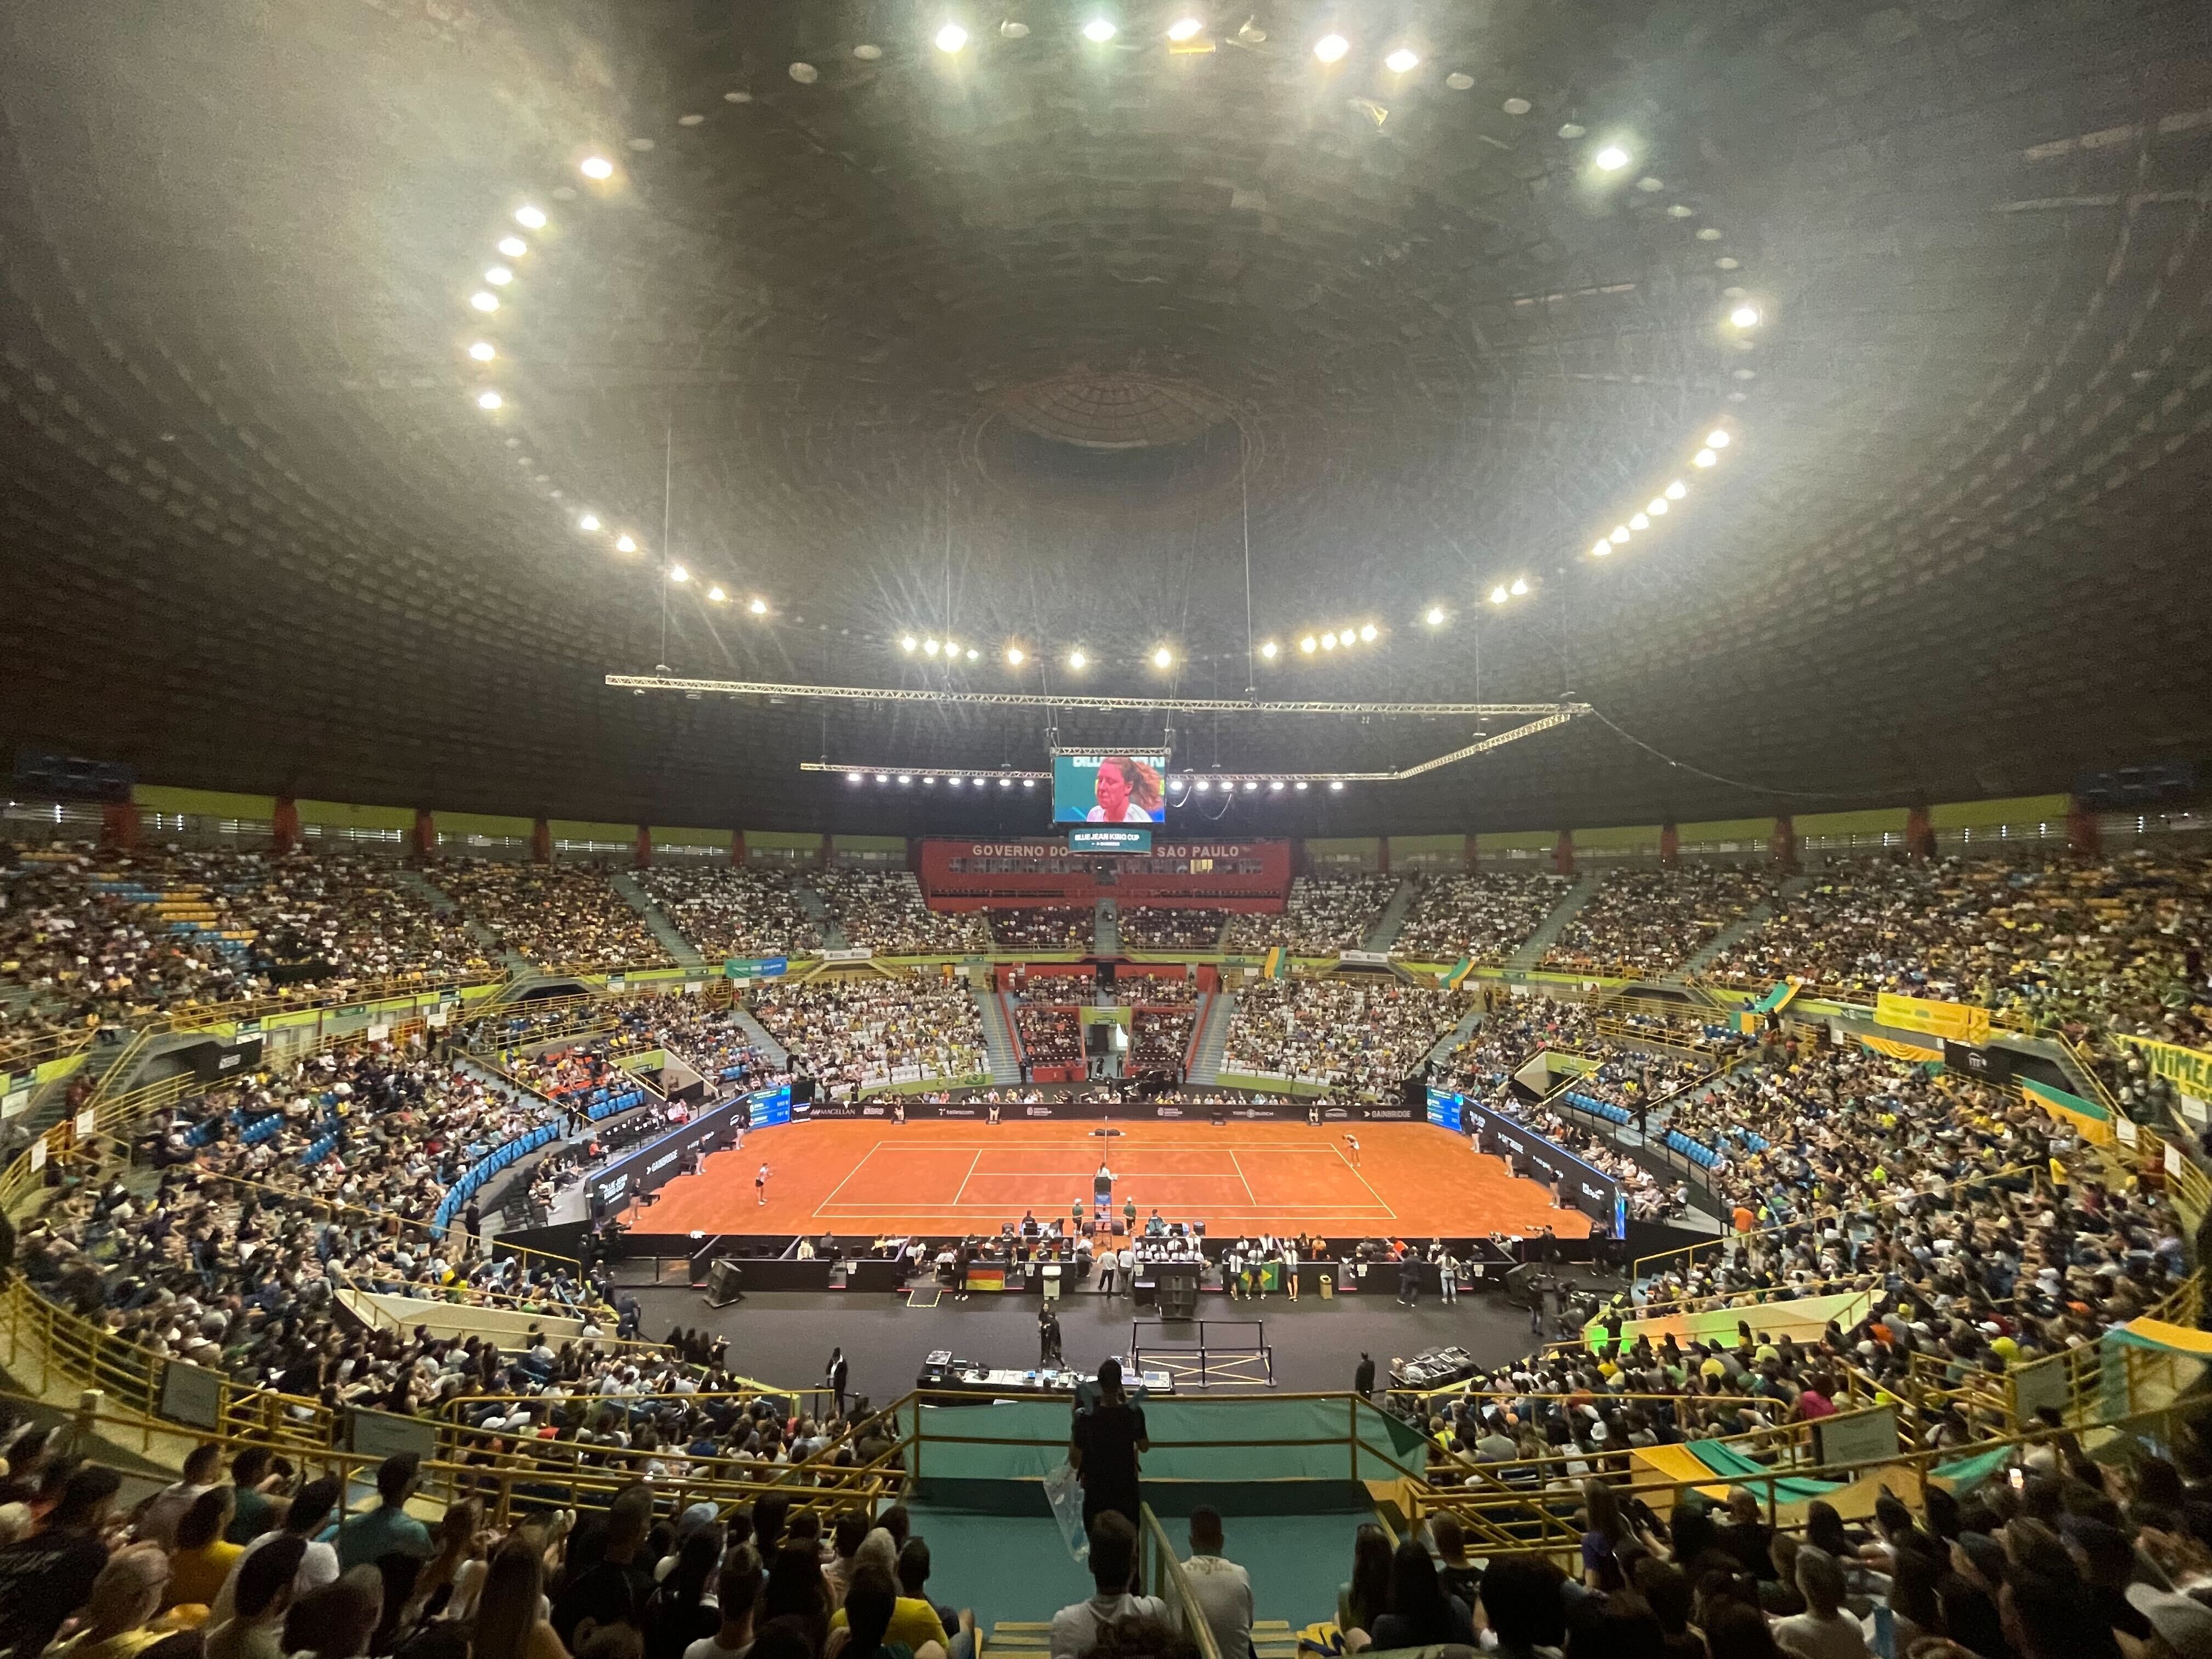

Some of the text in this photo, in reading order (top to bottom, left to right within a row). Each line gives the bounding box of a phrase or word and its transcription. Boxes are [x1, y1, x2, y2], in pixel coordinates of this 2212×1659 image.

[973, 845, 1044, 856] GOVERNO
[1049, 846, 1068, 857] DO
[1192, 846, 1239, 857] PAULO
